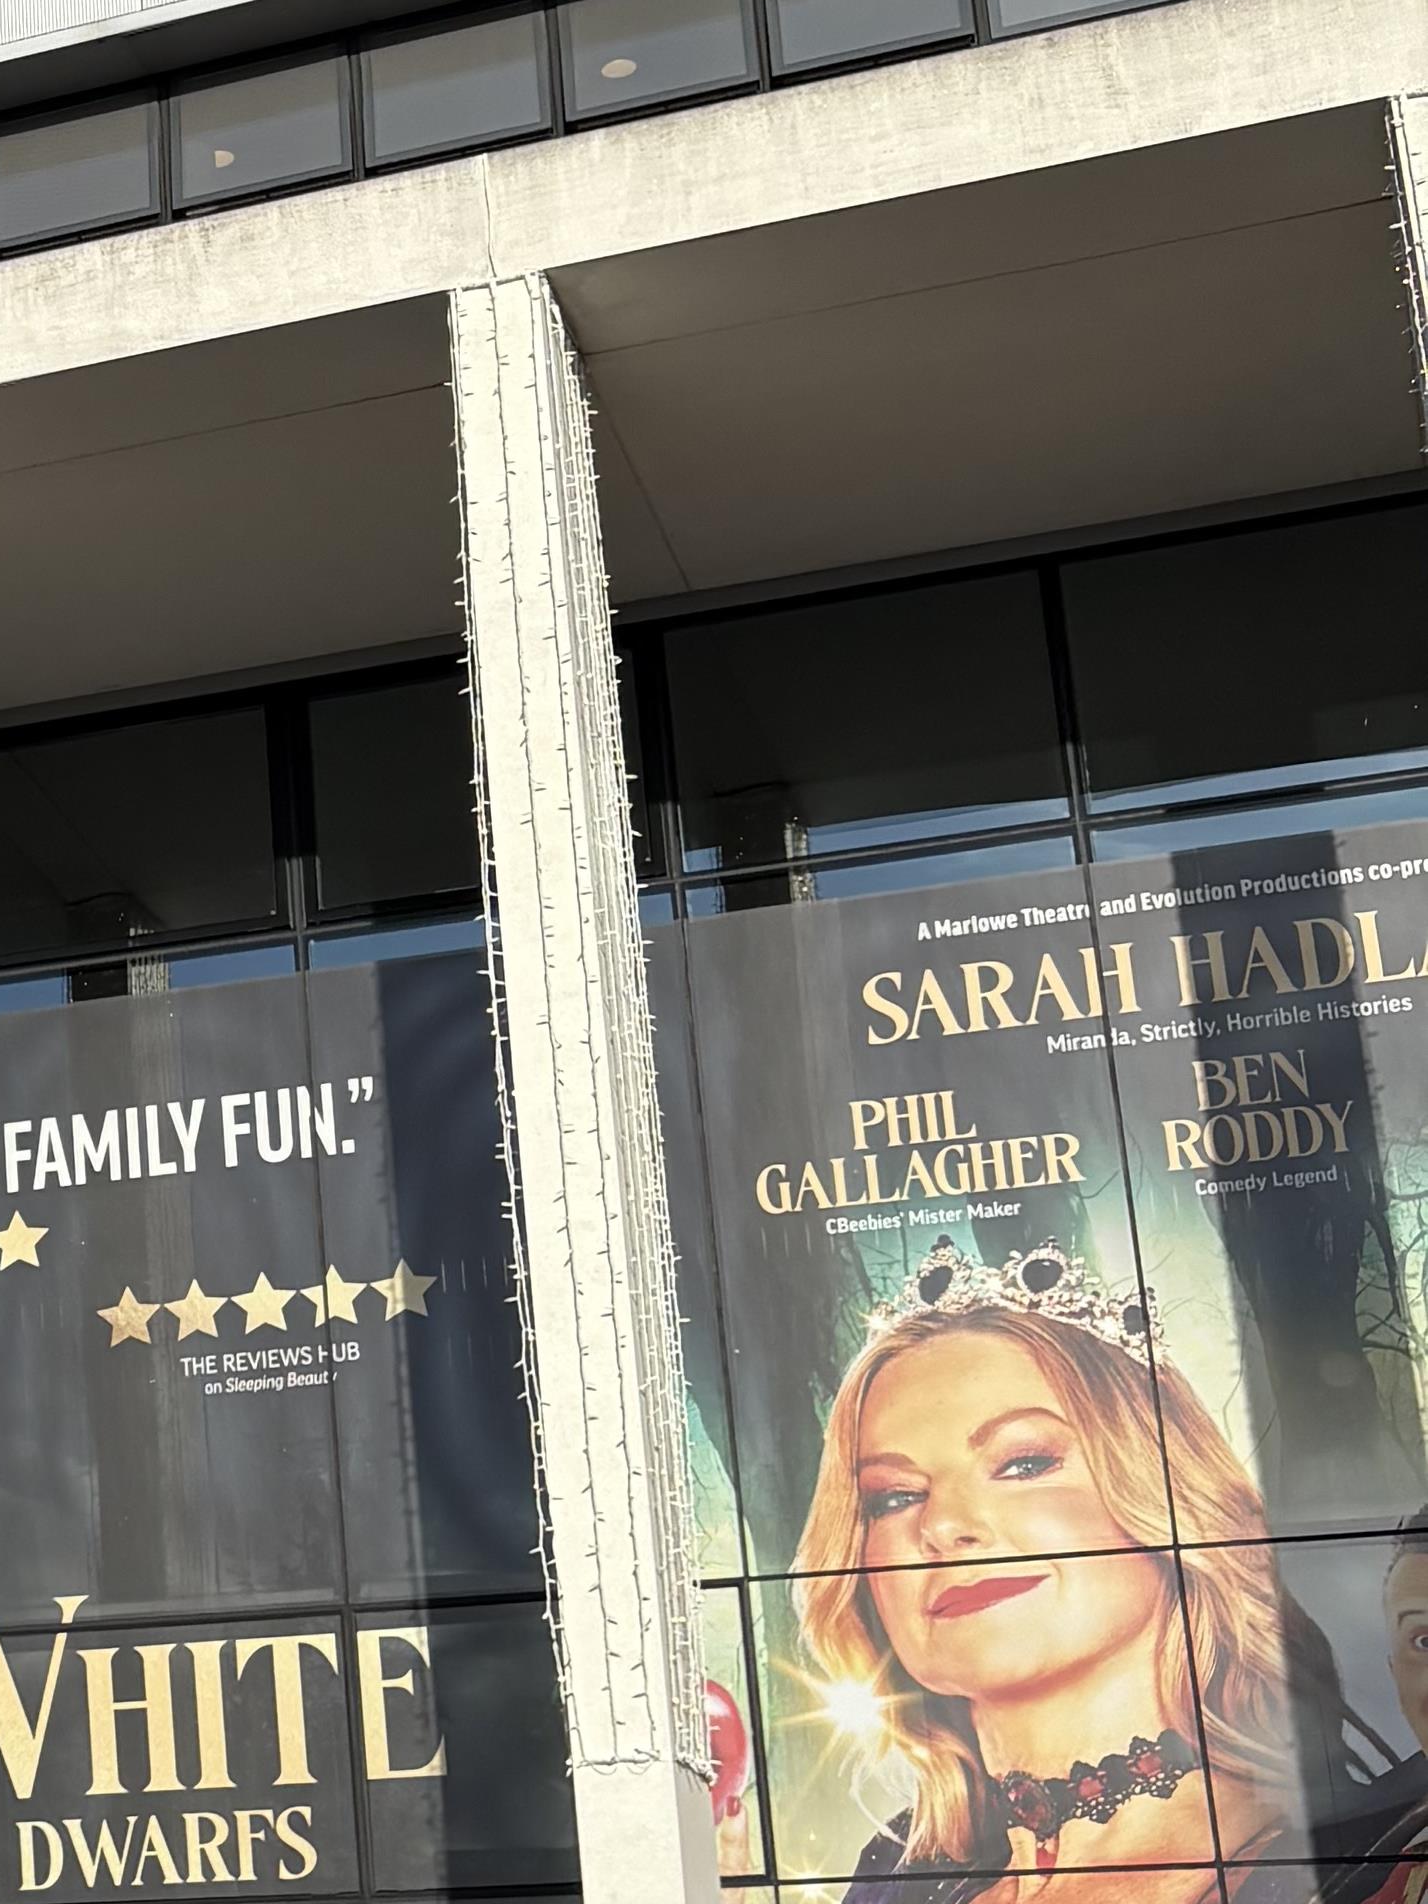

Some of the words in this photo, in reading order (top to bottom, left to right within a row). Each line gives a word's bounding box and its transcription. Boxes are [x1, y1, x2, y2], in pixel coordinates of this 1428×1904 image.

[917, 922, 932, 941] A
[934, 911, 1019, 938] Marlowe
[1100, 894, 1137, 916] and
[1140, 881, 1237, 912] Evolution
[1240, 865, 1365, 898] Productions
[862, 942, 1143, 1047] SARAH
[1168, 910, 1428, 1008] HADL
[1140, 1014, 1222, 1043] Strictly,
[1226, 1006, 1311, 1032] Horrible
[1317, 994, 1414, 1022] Histories
[1191, 1049, 1312, 1112] BEN
[4, 1097, 206, 1195] FAMILY
[221, 1075, 375, 1169] FUN.”
[849, 1090, 978, 1151] PHIL
[1161, 1100, 1355, 1172] RODDY
[755, 1132, 1088, 1215] GALLAGHER
[1194, 1173, 1268, 1197] Comedy
[1272, 1164, 1339, 1189] Legend
[908, 1206, 962, 1228] Mister
[966, 1200, 1022, 1221] Maker
[180, 1354, 218, 1377] THE
[223, 1346, 313, 1373] REVIEWS
[205, 1382, 223, 1395] on
[225, 1374, 285, 1394] Sleeping
[15, 1806, 319, 1893] DWARFS
